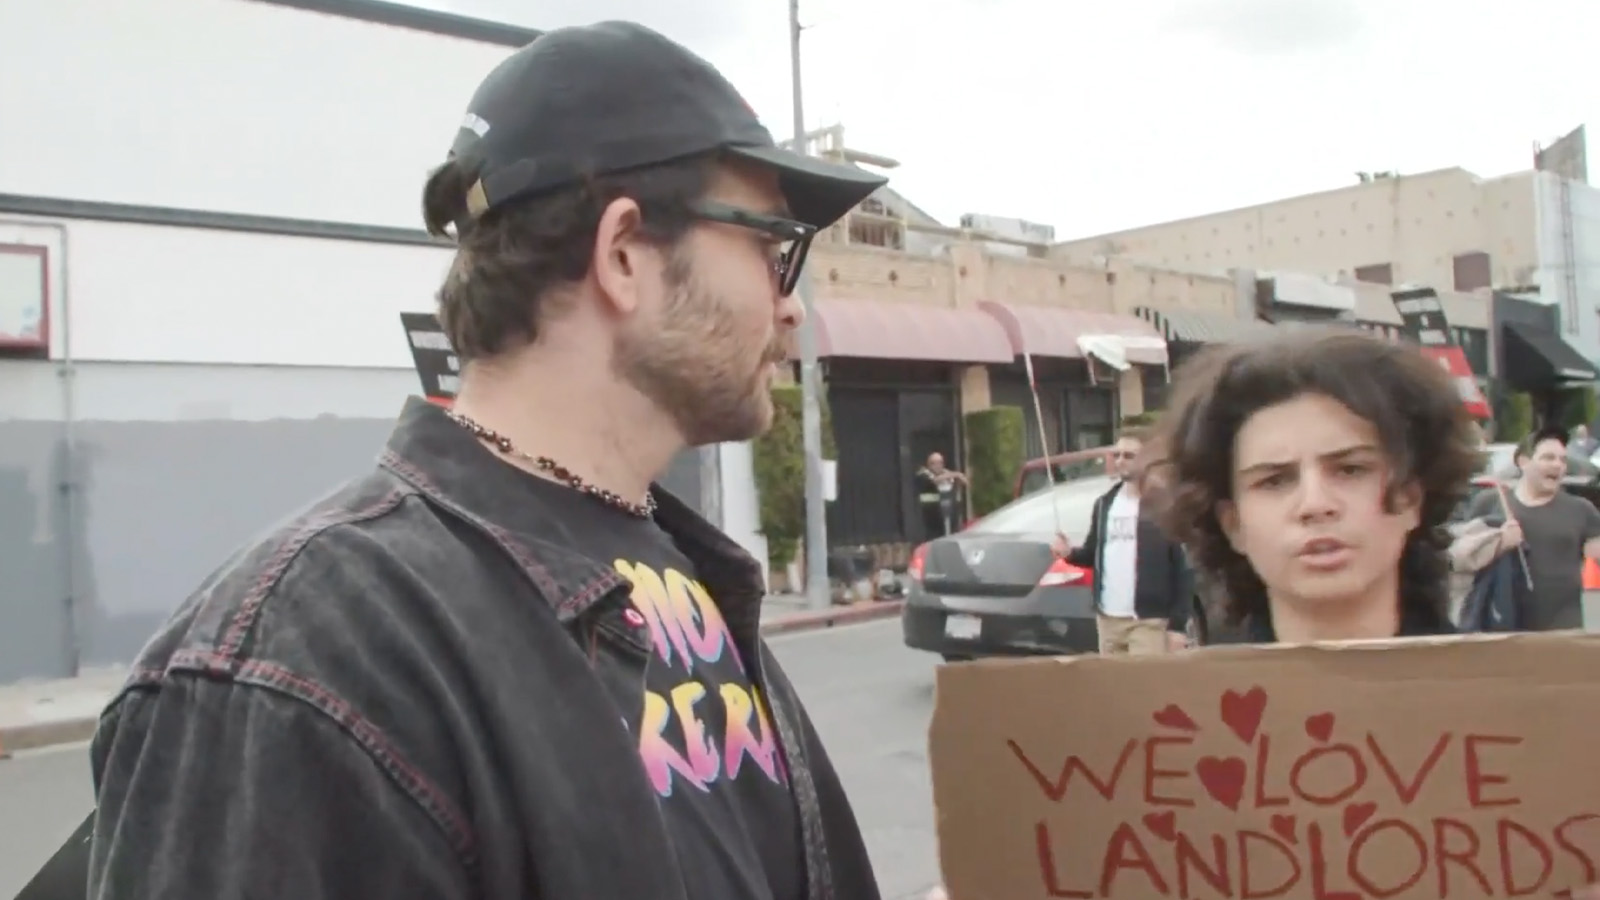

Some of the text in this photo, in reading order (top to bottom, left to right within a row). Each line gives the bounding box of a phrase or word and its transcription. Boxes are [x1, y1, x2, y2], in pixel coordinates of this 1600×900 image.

[1007, 732, 1524, 809] WE LOVE
[1035, 813, 1600, 900] LANDLORDS
